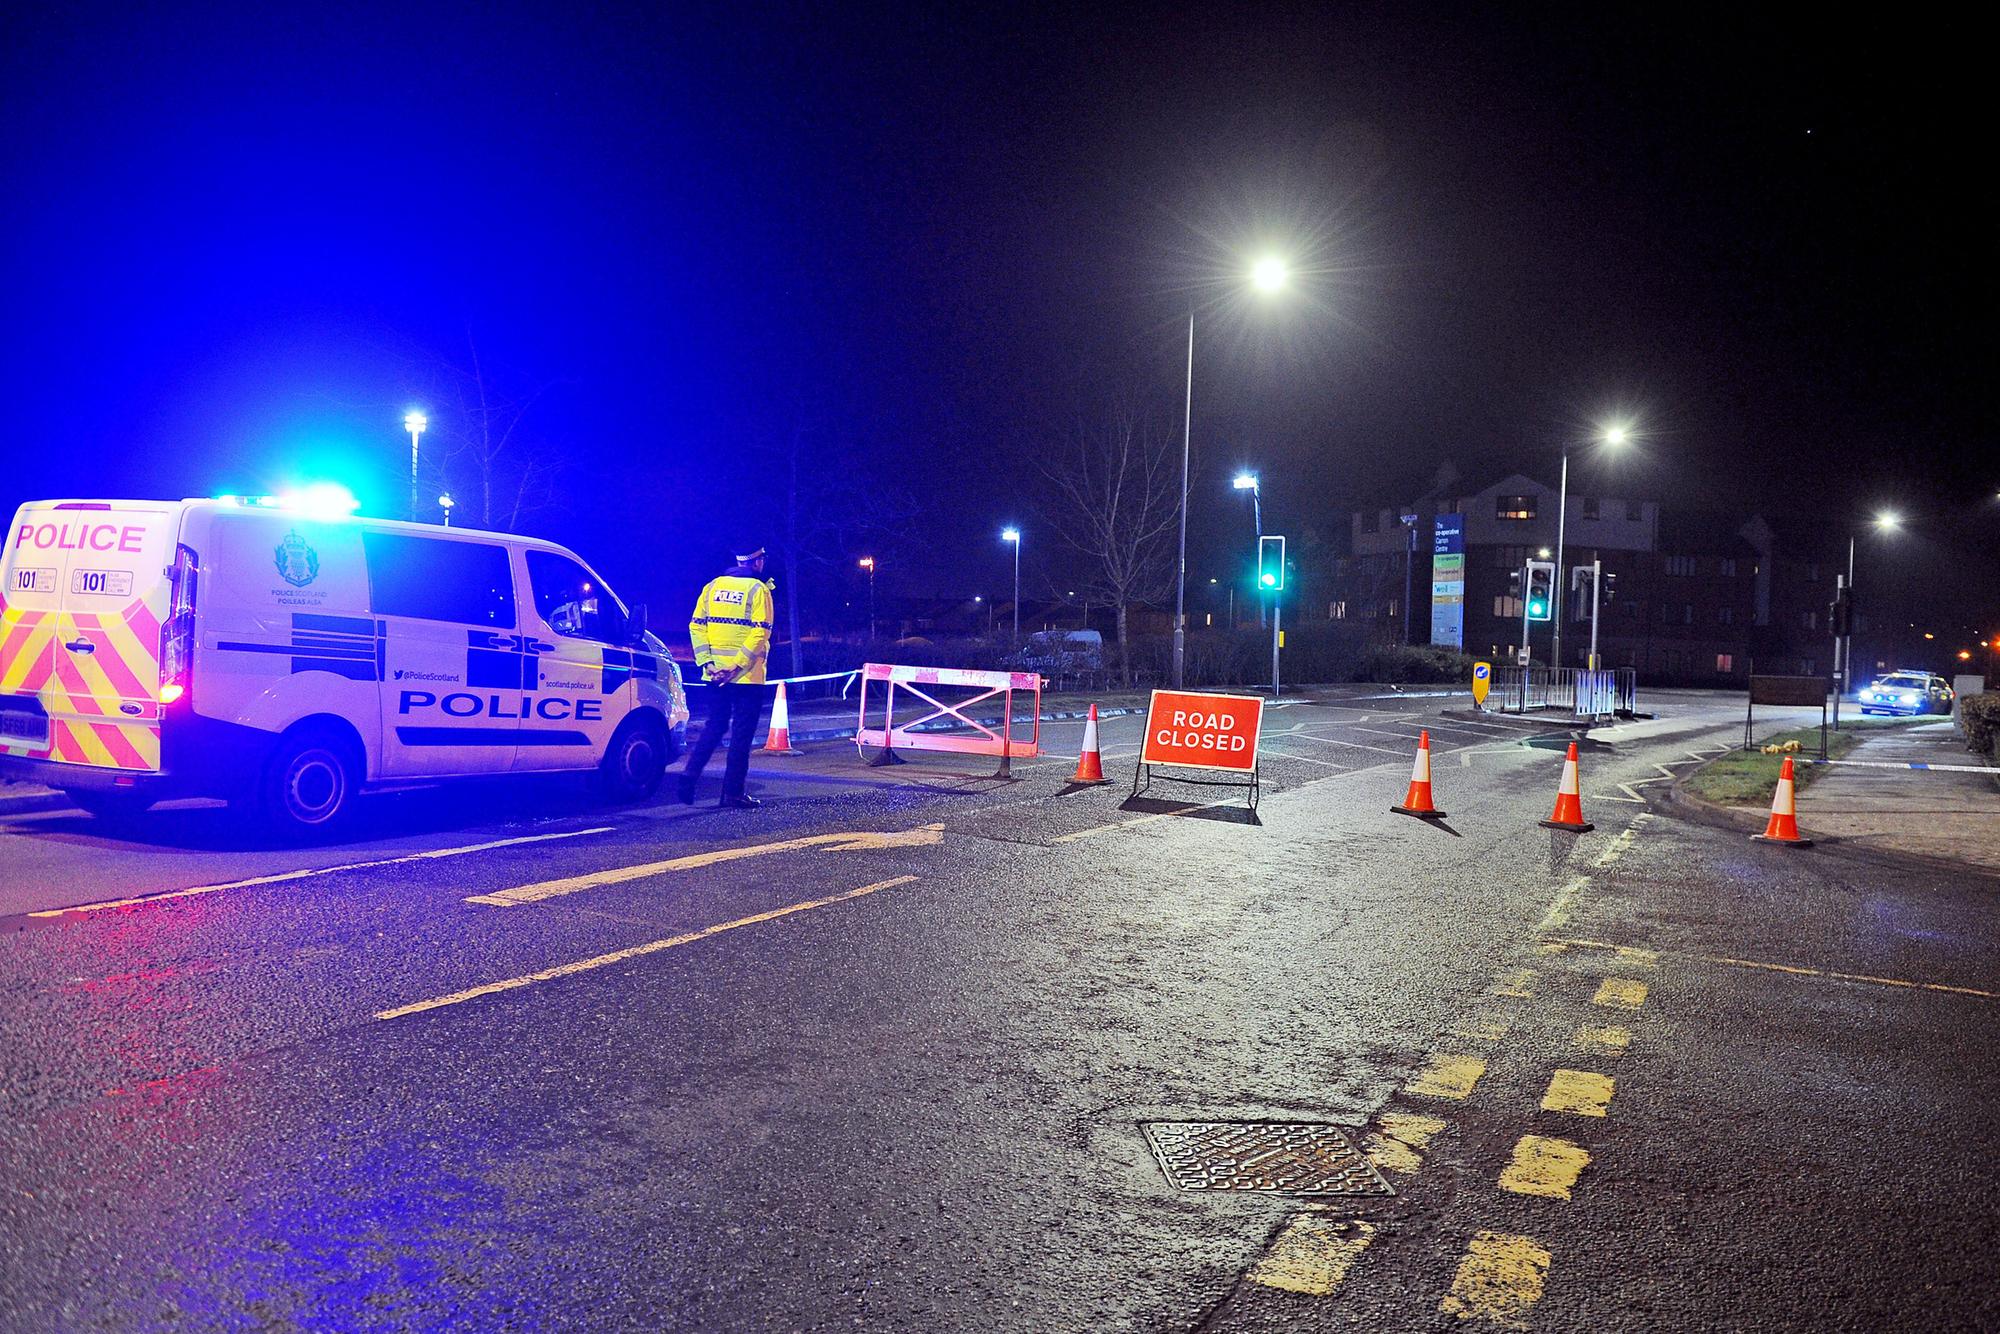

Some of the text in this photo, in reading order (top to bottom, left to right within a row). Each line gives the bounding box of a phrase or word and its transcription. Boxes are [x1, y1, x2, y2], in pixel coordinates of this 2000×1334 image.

[16, 524, 146, 552] POLICE
[18, 571, 36, 588] 101
[83, 573, 106, 591] 101
[714, 590, 744, 602] POLICE
[403, 670, 459, 682] @PoliceScotland
[546, 680, 595, 690] scotland.police.uk
[398, 690, 602, 721] POLICE
[1173, 711, 1235, 731] ROAD
[1157, 730, 1246, 752] CLOSED
